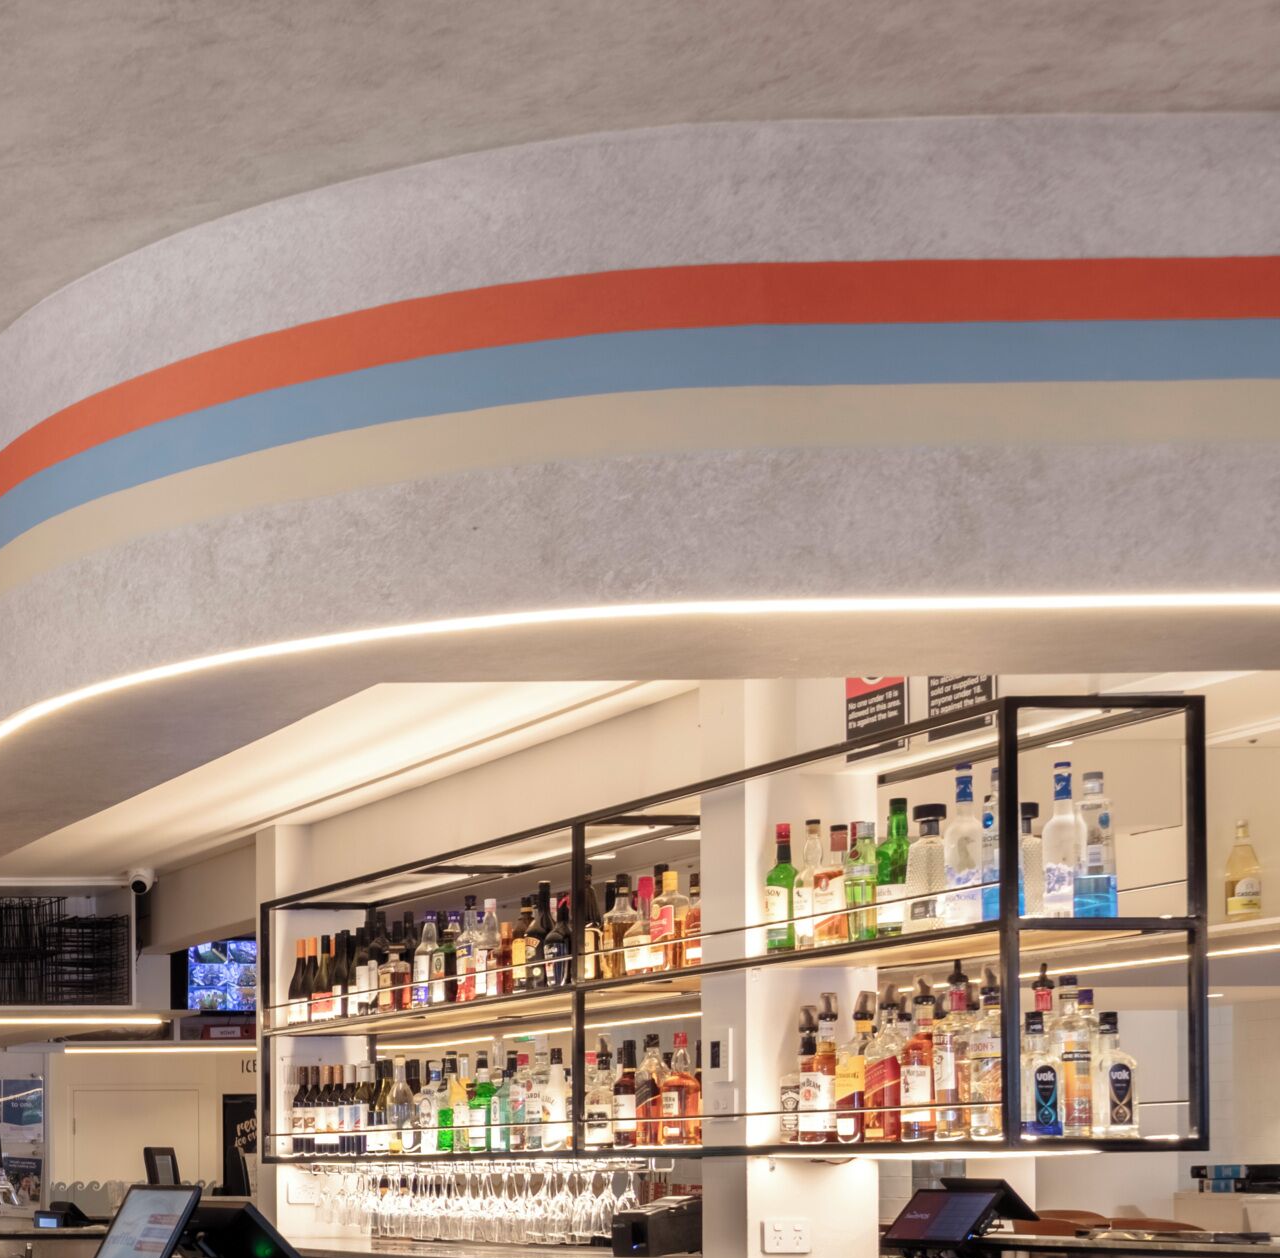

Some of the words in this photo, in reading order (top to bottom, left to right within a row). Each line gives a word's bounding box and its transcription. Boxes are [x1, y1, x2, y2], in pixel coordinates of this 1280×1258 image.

[930, 678, 939, 687] No
[930, 686, 943, 696] sold
[952, 676, 979, 690] supplied
[848, 702, 856, 710] No
[857, 699, 867, 708] one
[868, 694, 885, 705] under
[930, 694, 952, 706] anyone
[953, 688, 971, 700] under
[963, 698, 974, 707] the
[848, 708, 869, 720] allowed
[876, 703, 886, 712] this
[857, 715, 877, 728] against
[877, 712, 886, 721] the
[1037, 1071, 1055, 1081] vok
[1111, 1070, 1130, 1080] vok
